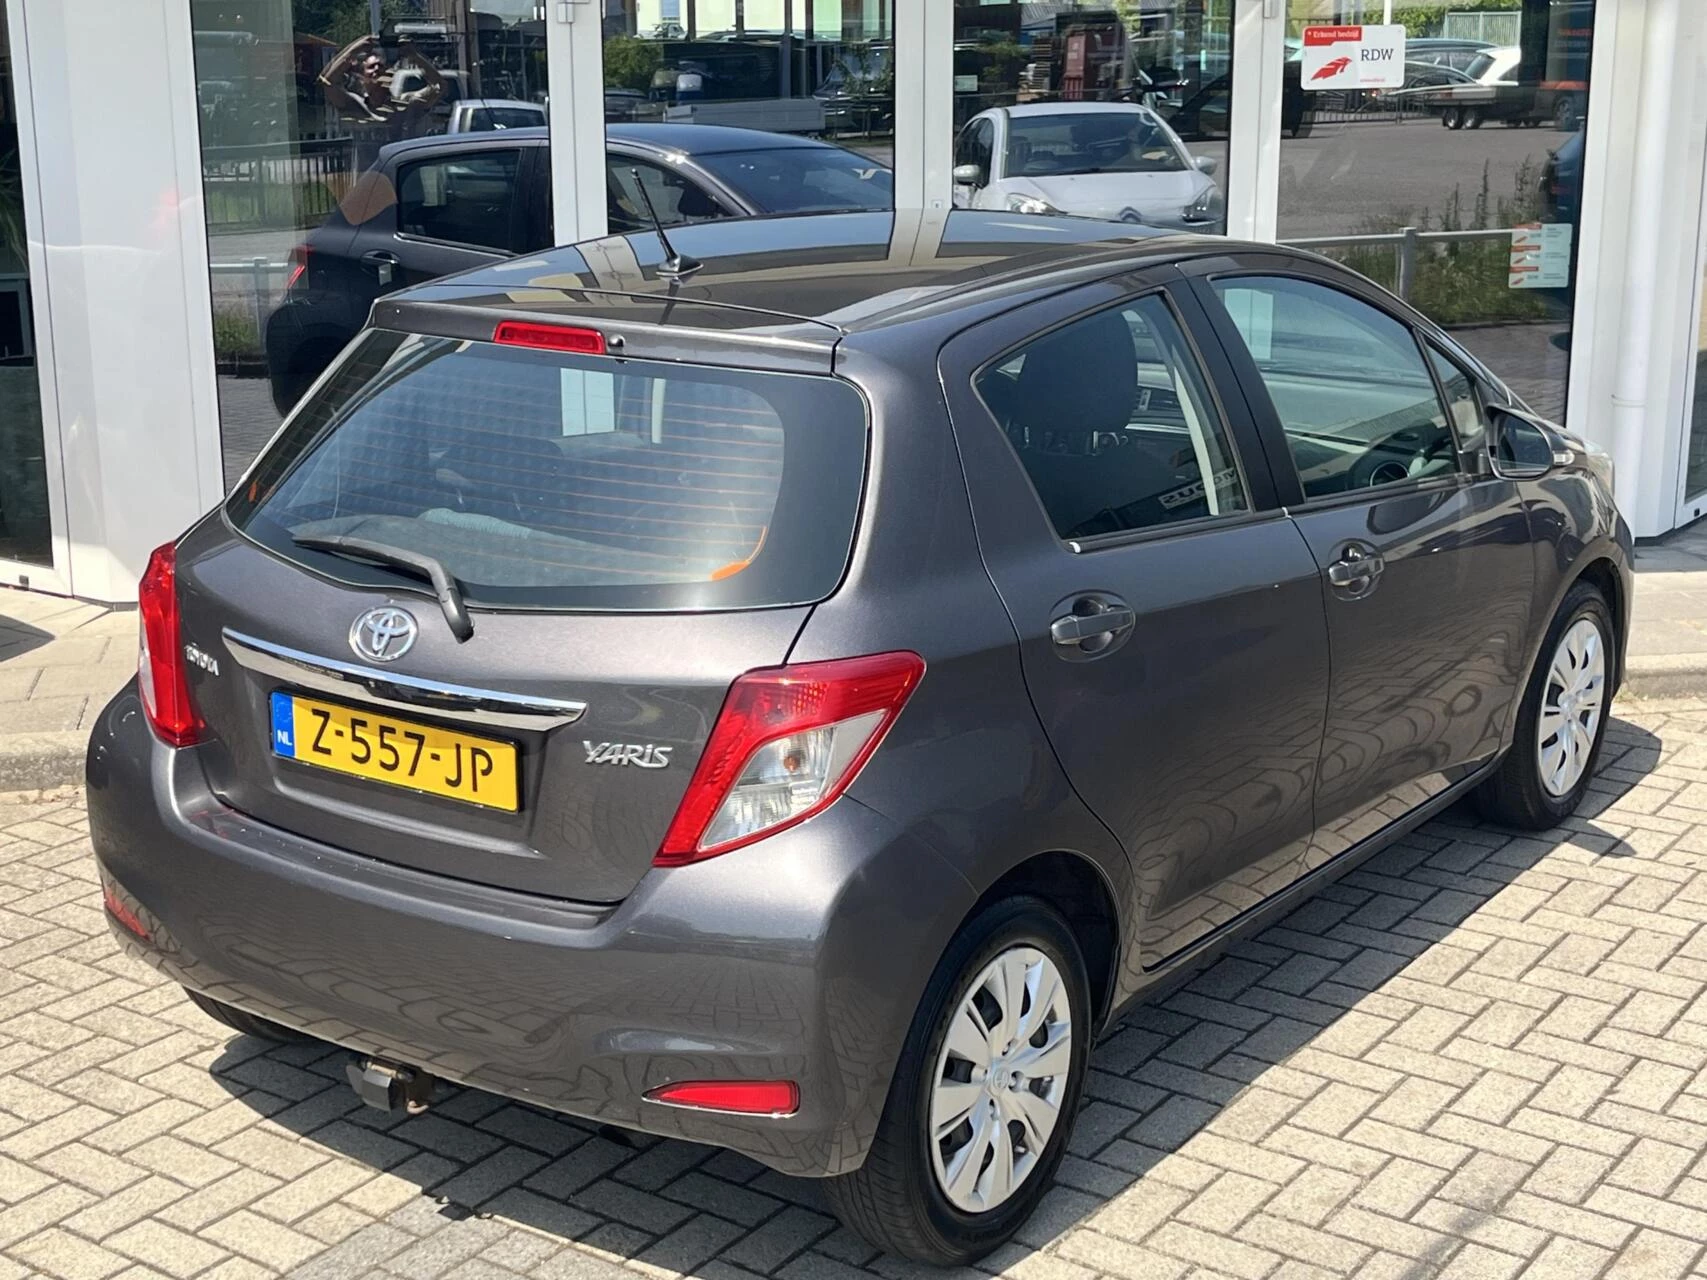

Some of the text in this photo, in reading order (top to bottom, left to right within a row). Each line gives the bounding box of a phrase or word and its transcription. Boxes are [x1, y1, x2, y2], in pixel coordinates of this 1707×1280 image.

[1361, 48, 1394, 61] RDW
[277, 729, 293, 747] NL
[311, 708, 493, 792] Z-557-JP
